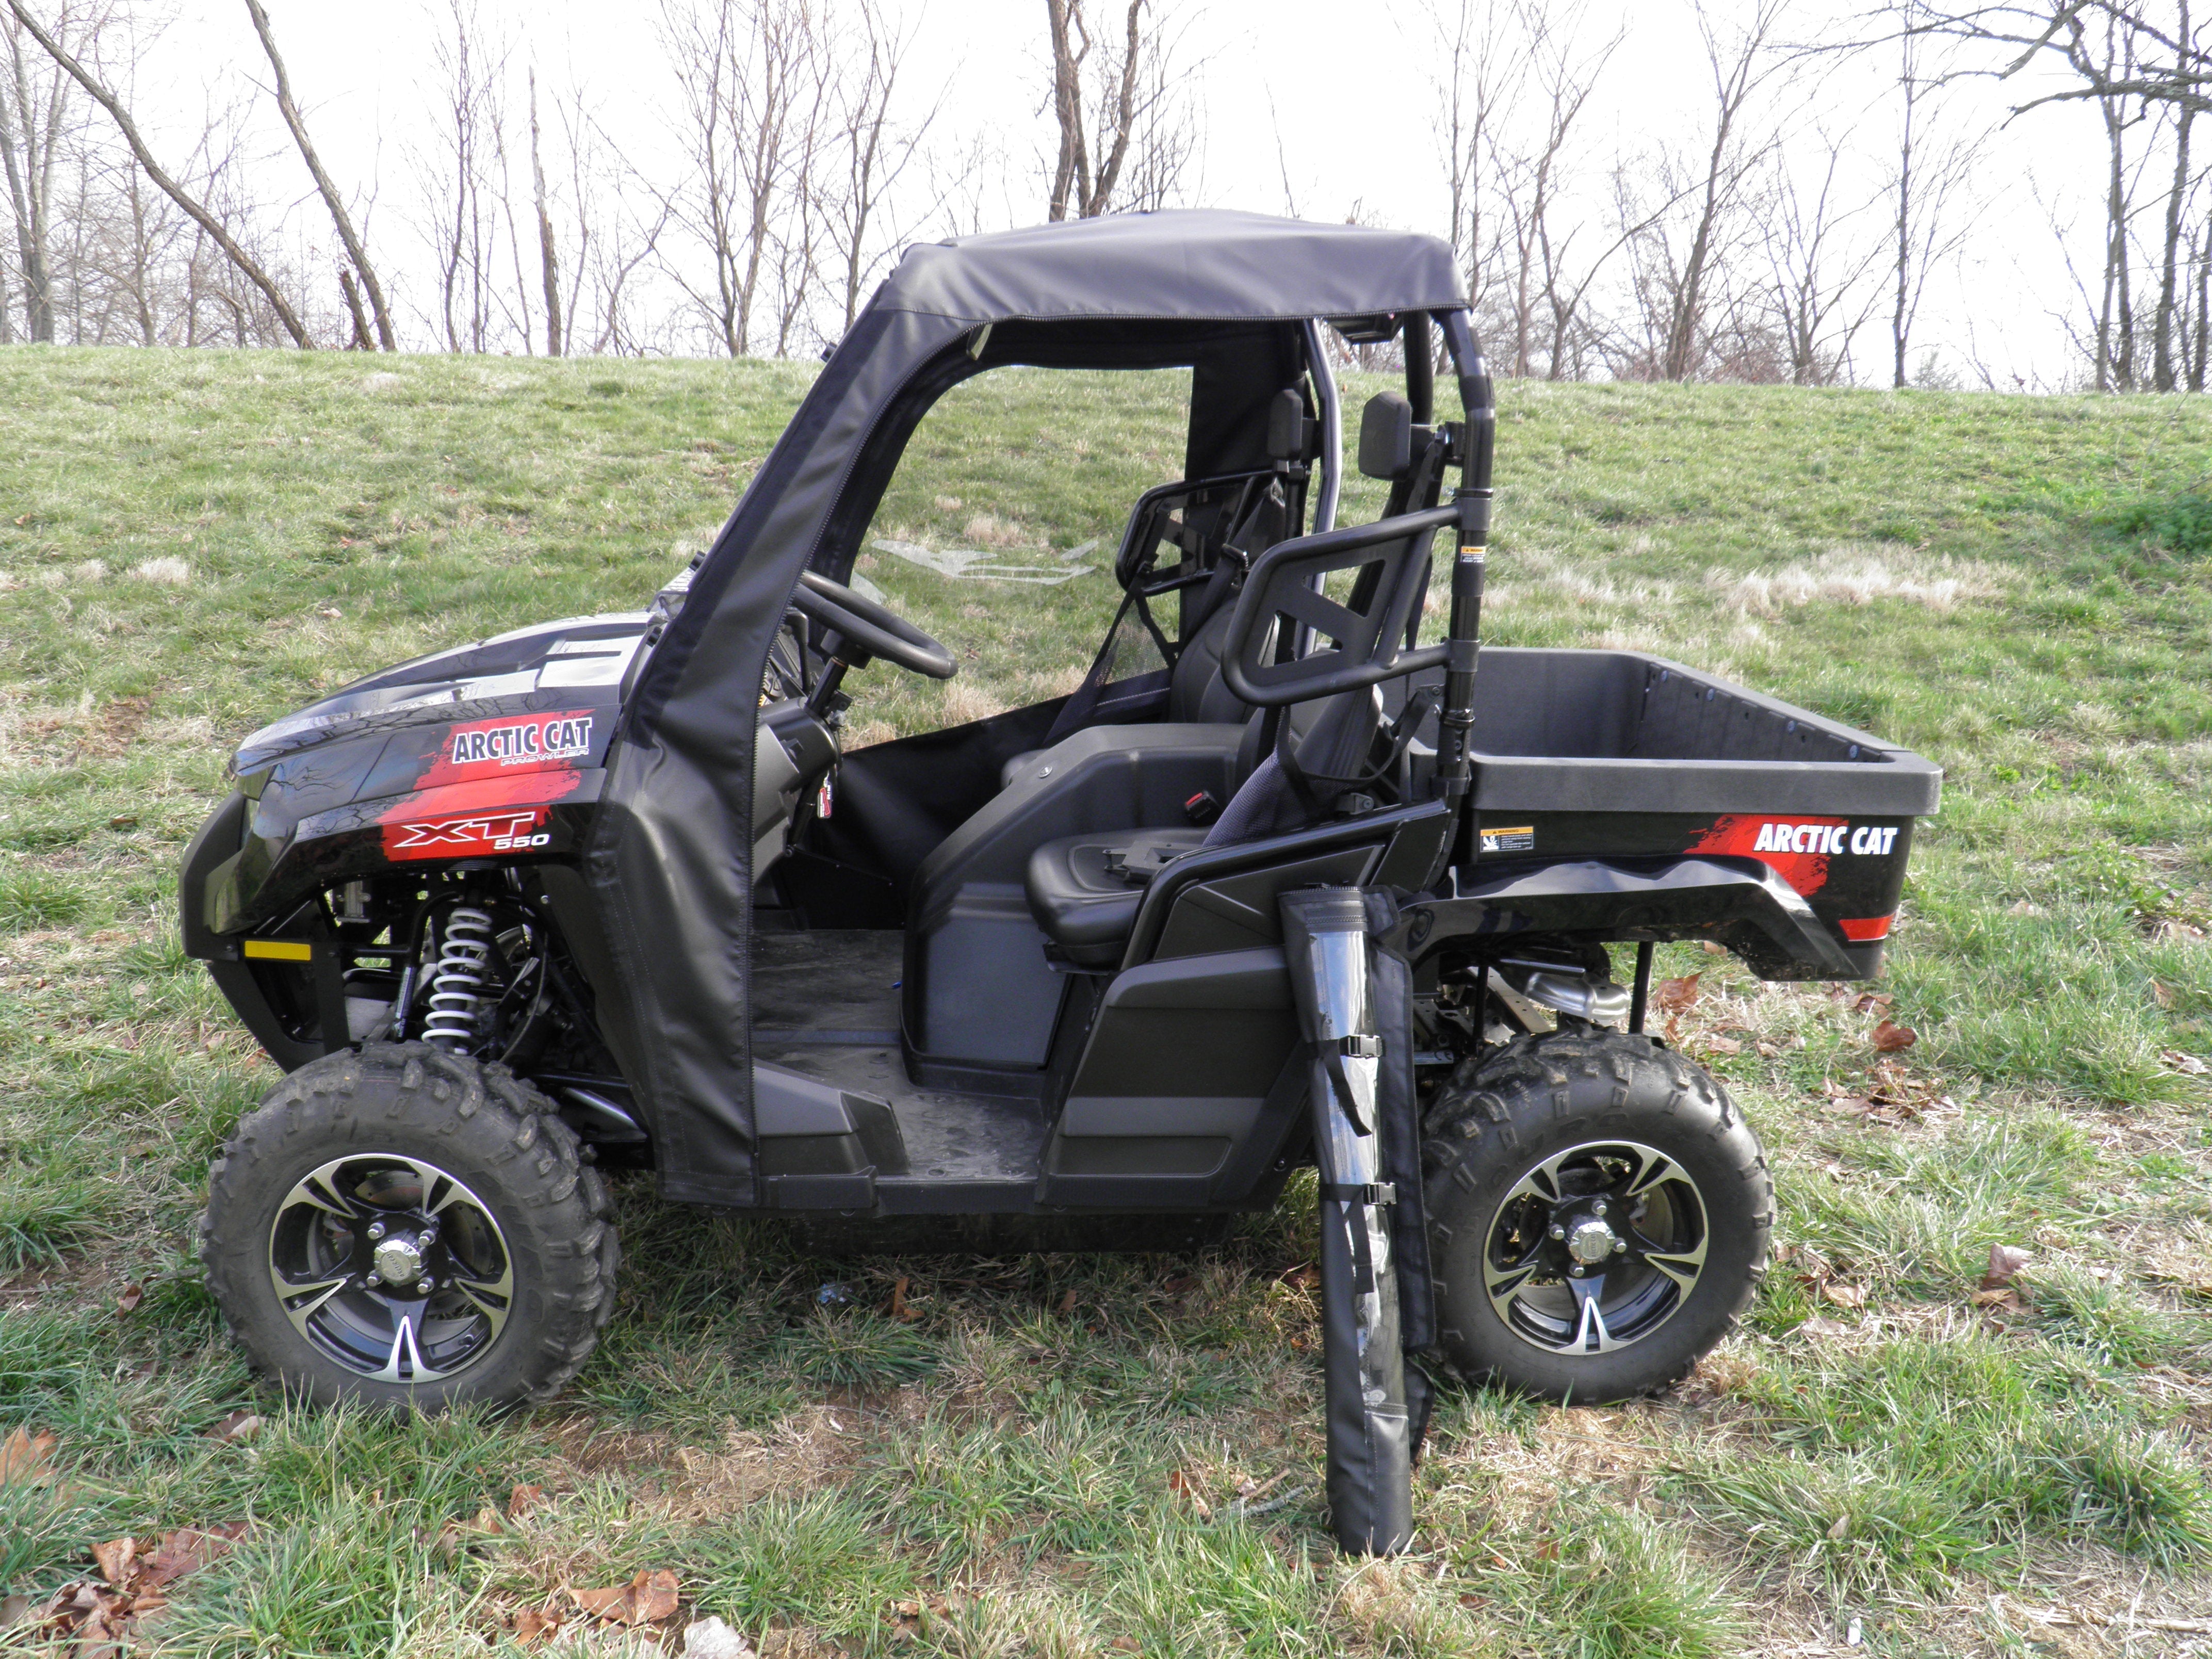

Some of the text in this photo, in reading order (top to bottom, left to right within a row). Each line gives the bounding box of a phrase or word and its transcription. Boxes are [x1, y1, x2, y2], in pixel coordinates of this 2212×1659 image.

[452, 718, 592, 764] ARCTIC CAT
[500, 747, 589, 767] PROWLER
[393, 811, 535, 848] XT
[494, 834, 550, 850] 550
[1753, 823, 1899, 855] ARCTIC CAT
